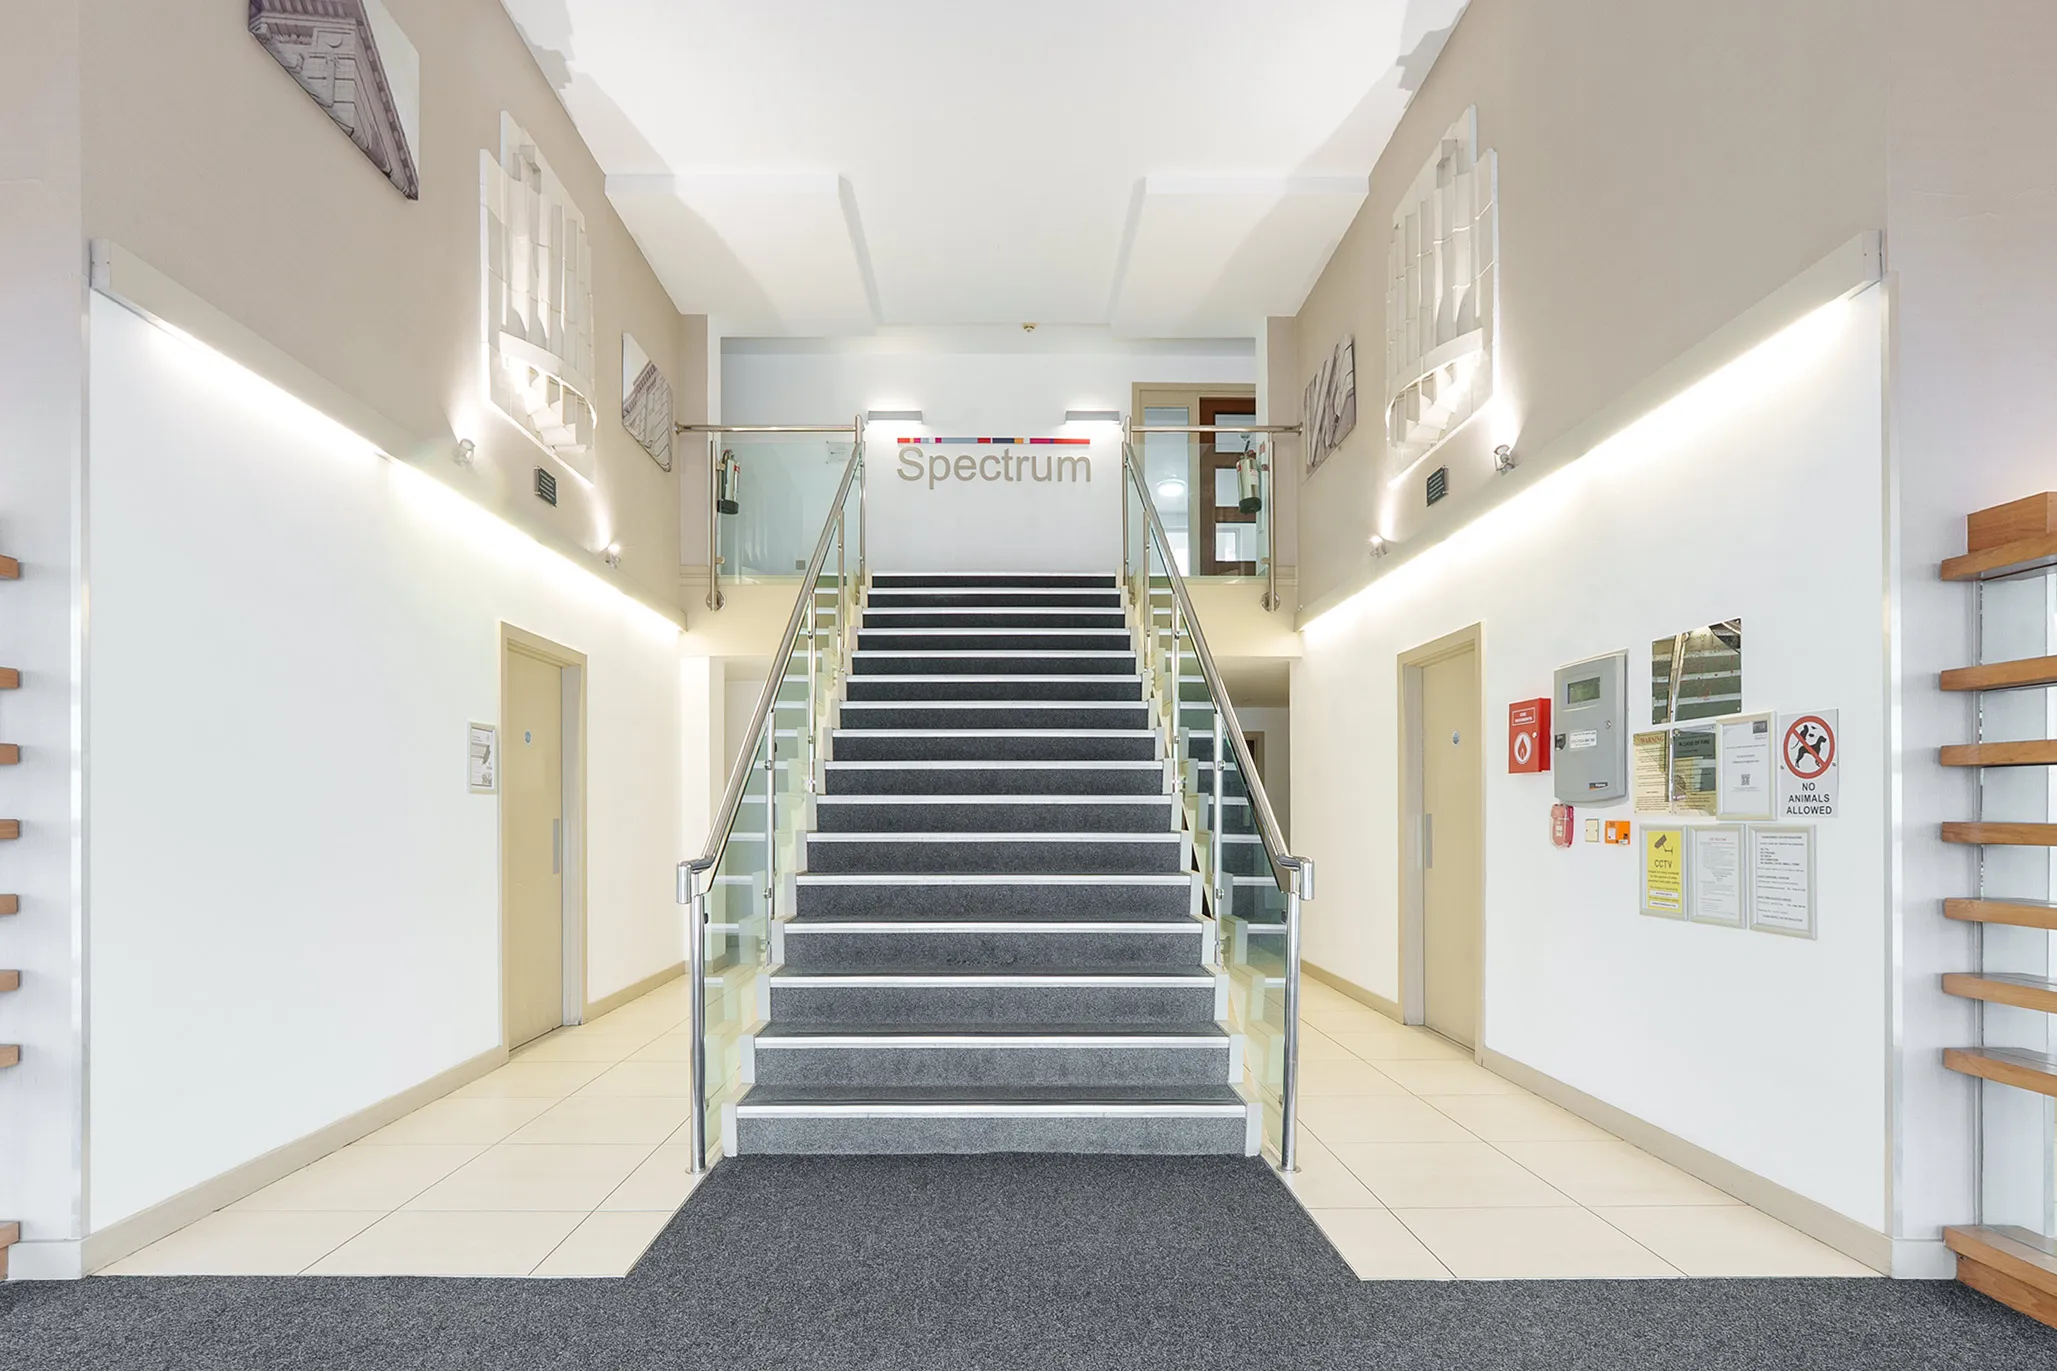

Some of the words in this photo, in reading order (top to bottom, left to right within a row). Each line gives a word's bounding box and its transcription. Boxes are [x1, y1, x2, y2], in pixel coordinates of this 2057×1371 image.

[896, 446, 1092, 490] Spectrum
[1639, 735, 1664, 744] WARNING
[1801, 782, 1816, 791] NO
[1788, 793, 1830, 803] ANIMALS
[1786, 805, 1833, 815] ALLOWED
[1654, 859, 1673, 869] CCTV
